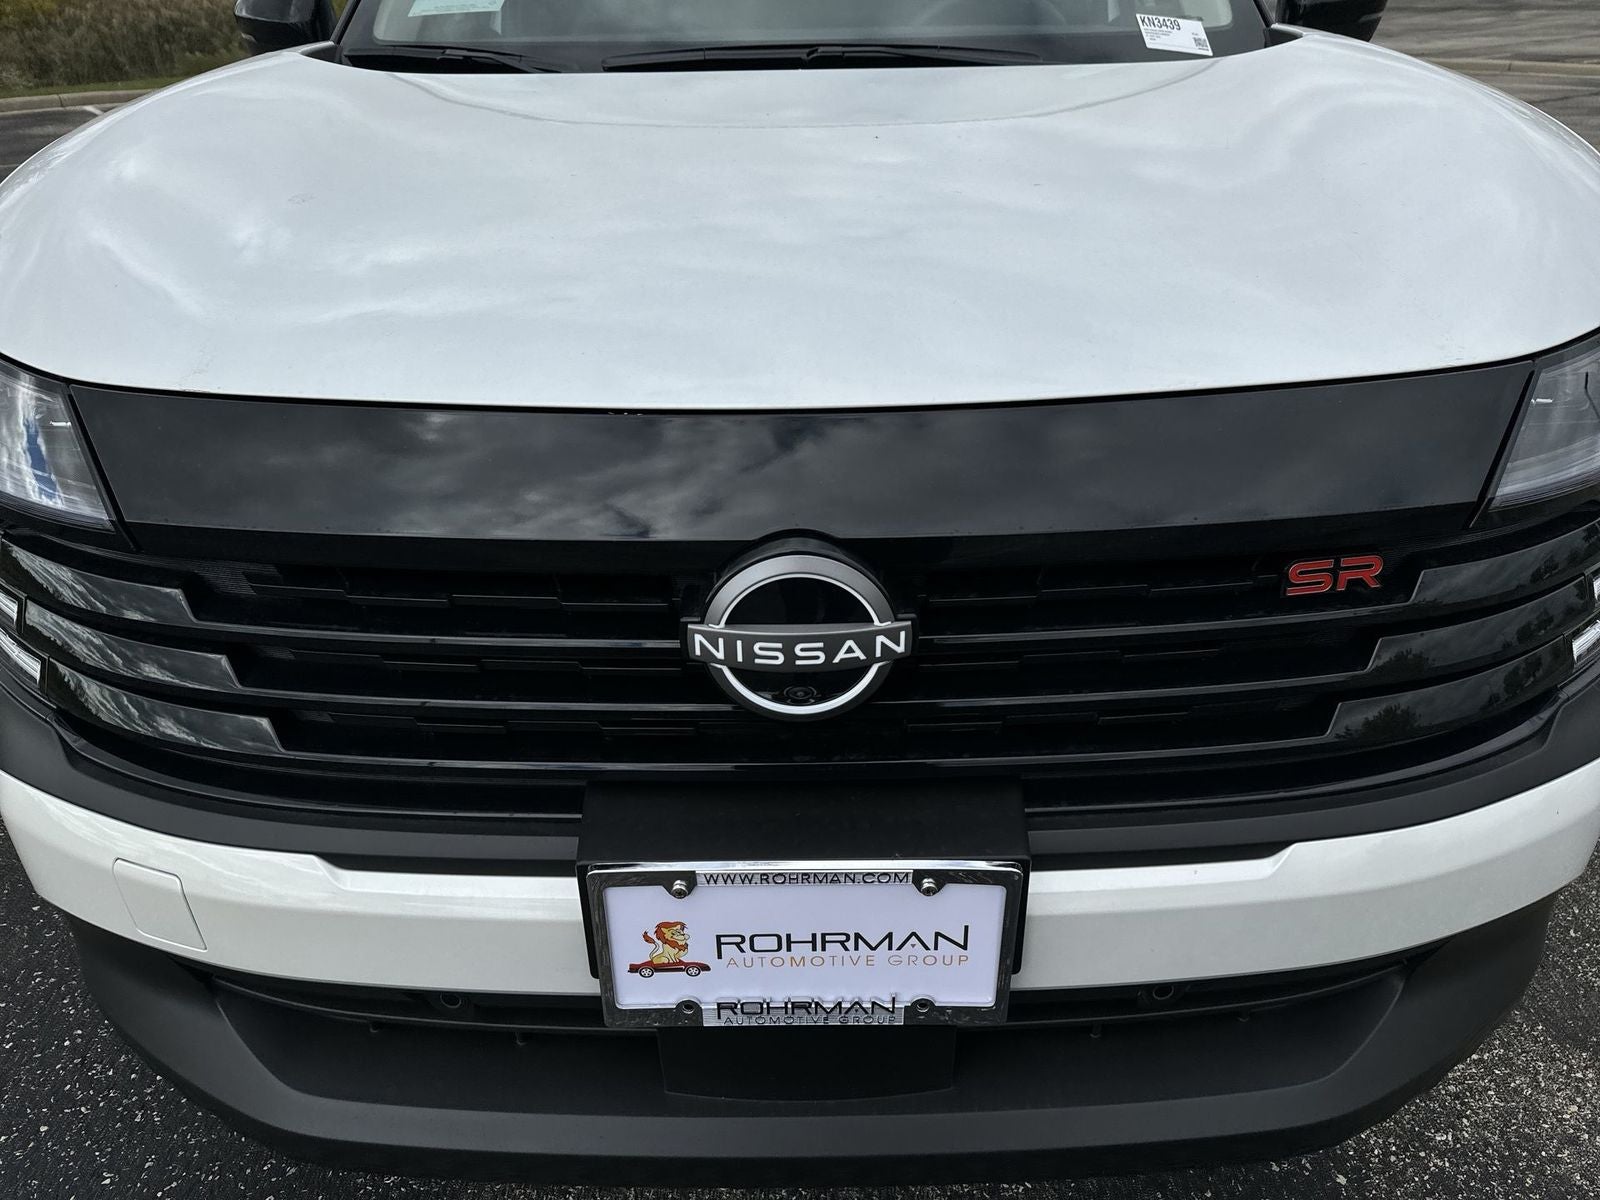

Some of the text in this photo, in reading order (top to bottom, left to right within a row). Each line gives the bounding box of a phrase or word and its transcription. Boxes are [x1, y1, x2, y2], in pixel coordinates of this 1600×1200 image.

[1139, 15, 1181, 31] KN3439
[1286, 554, 1384, 596] SR
[694, 630, 906, 665] NISSAN
[703, 872, 910, 886] WWW.ROHRMAN.COM
[715, 924, 970, 960] ROHRMAN
[726, 954, 970, 968] AUTOMOTIVE GROUP
[716, 996, 897, 1019] ROHRMAN
[723, 1015, 897, 1026] AUTOMOTIVE GROUP
